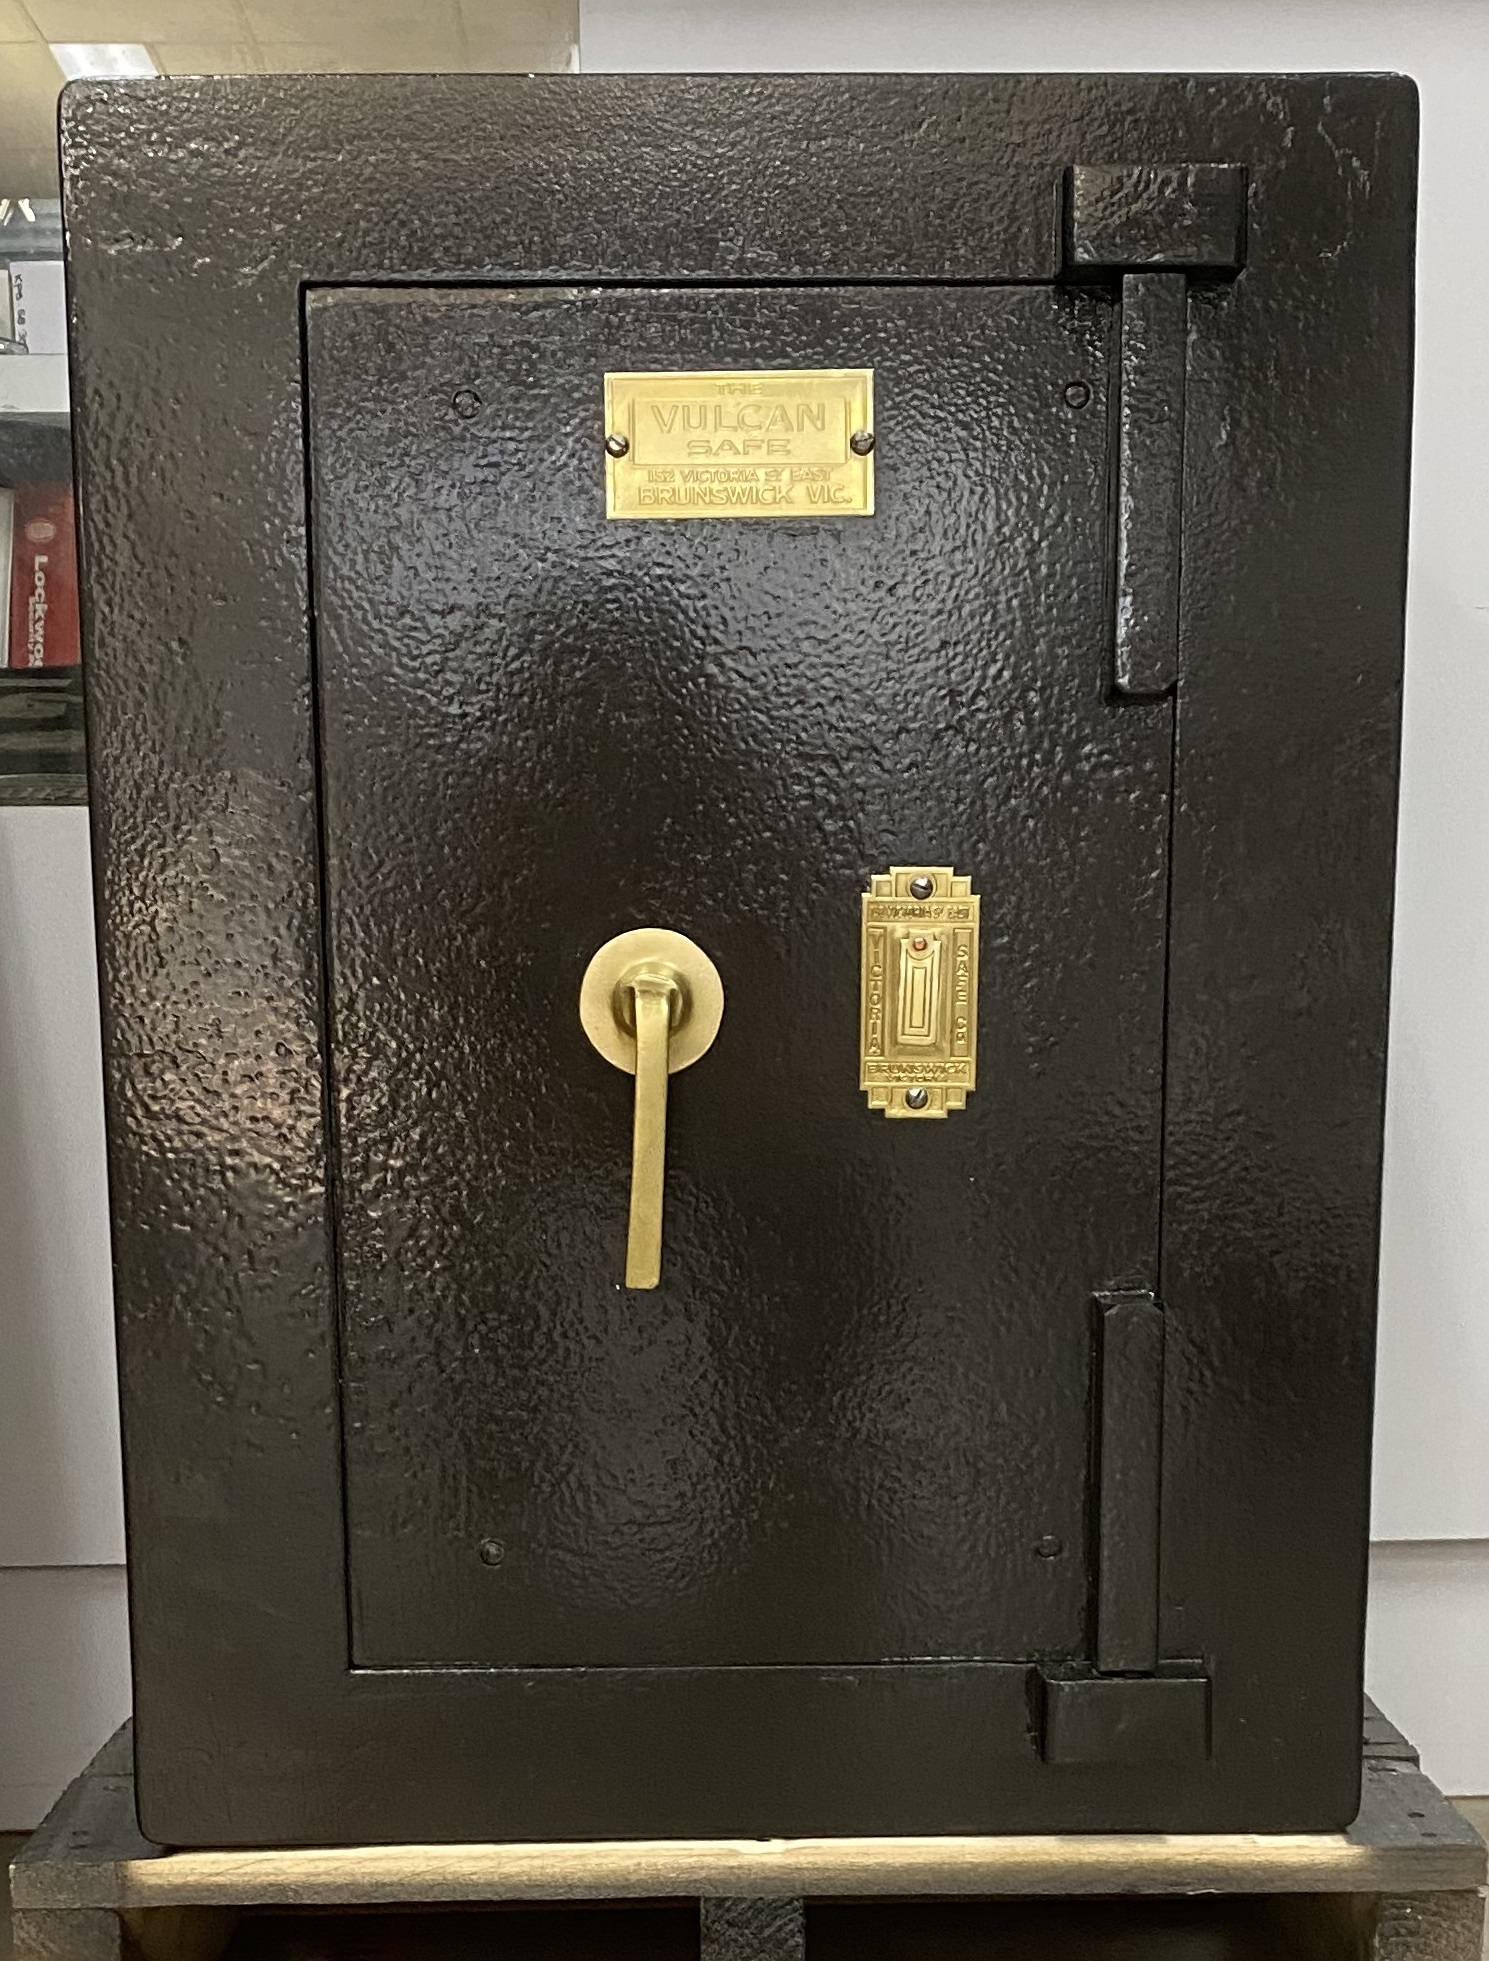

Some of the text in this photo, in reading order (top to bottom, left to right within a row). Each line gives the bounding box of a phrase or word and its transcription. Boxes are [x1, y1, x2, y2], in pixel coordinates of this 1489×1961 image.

[714, 383, 763, 395] THE
[650, 403, 826, 433] VULCAN
[686, 438, 792, 457] SAFE
[647, 468, 676, 483] 152
[681, 468, 760, 483] VICTORIA
[792, 467, 833, 481] EAST
[637, 483, 853, 505] BRUNSWICK VIC.
[954, 944, 969, 1006] SAFE
[868, 932, 885, 1056] VICTORIA
[866, 1062, 968, 1075] BRUNSWICK
